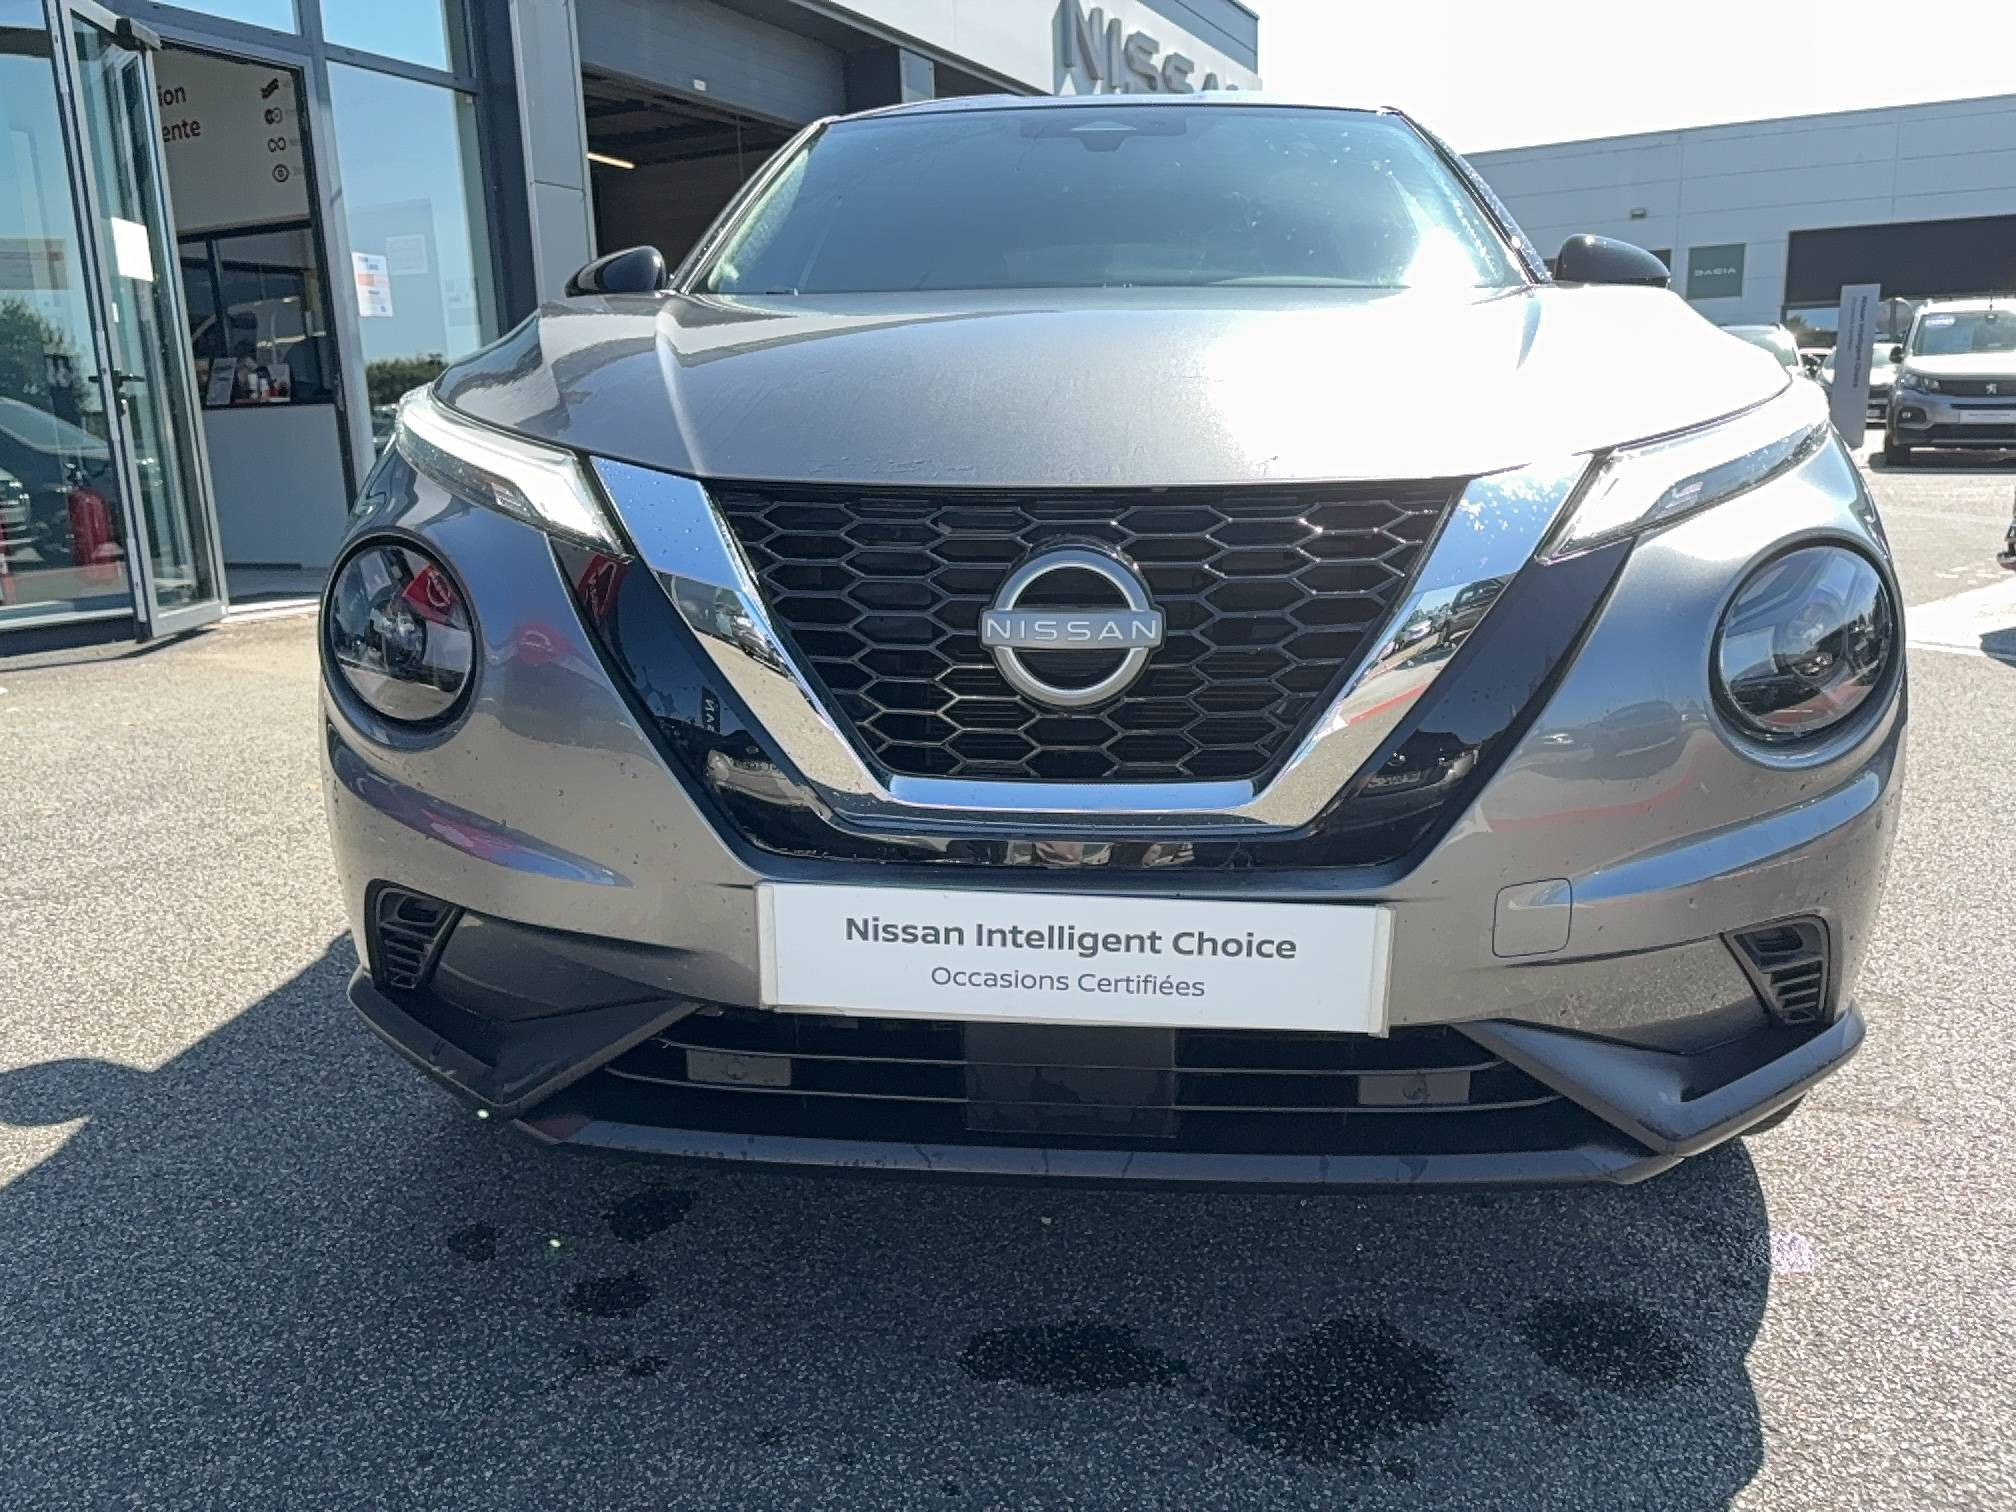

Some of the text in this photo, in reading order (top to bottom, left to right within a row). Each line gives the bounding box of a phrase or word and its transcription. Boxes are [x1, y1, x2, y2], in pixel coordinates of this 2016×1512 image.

[986, 619, 1157, 641] NISSAN
[845, 916, 1297, 959] Nissan Intelligent Choice
[931, 966, 1206, 997] Occasions Certifiées
